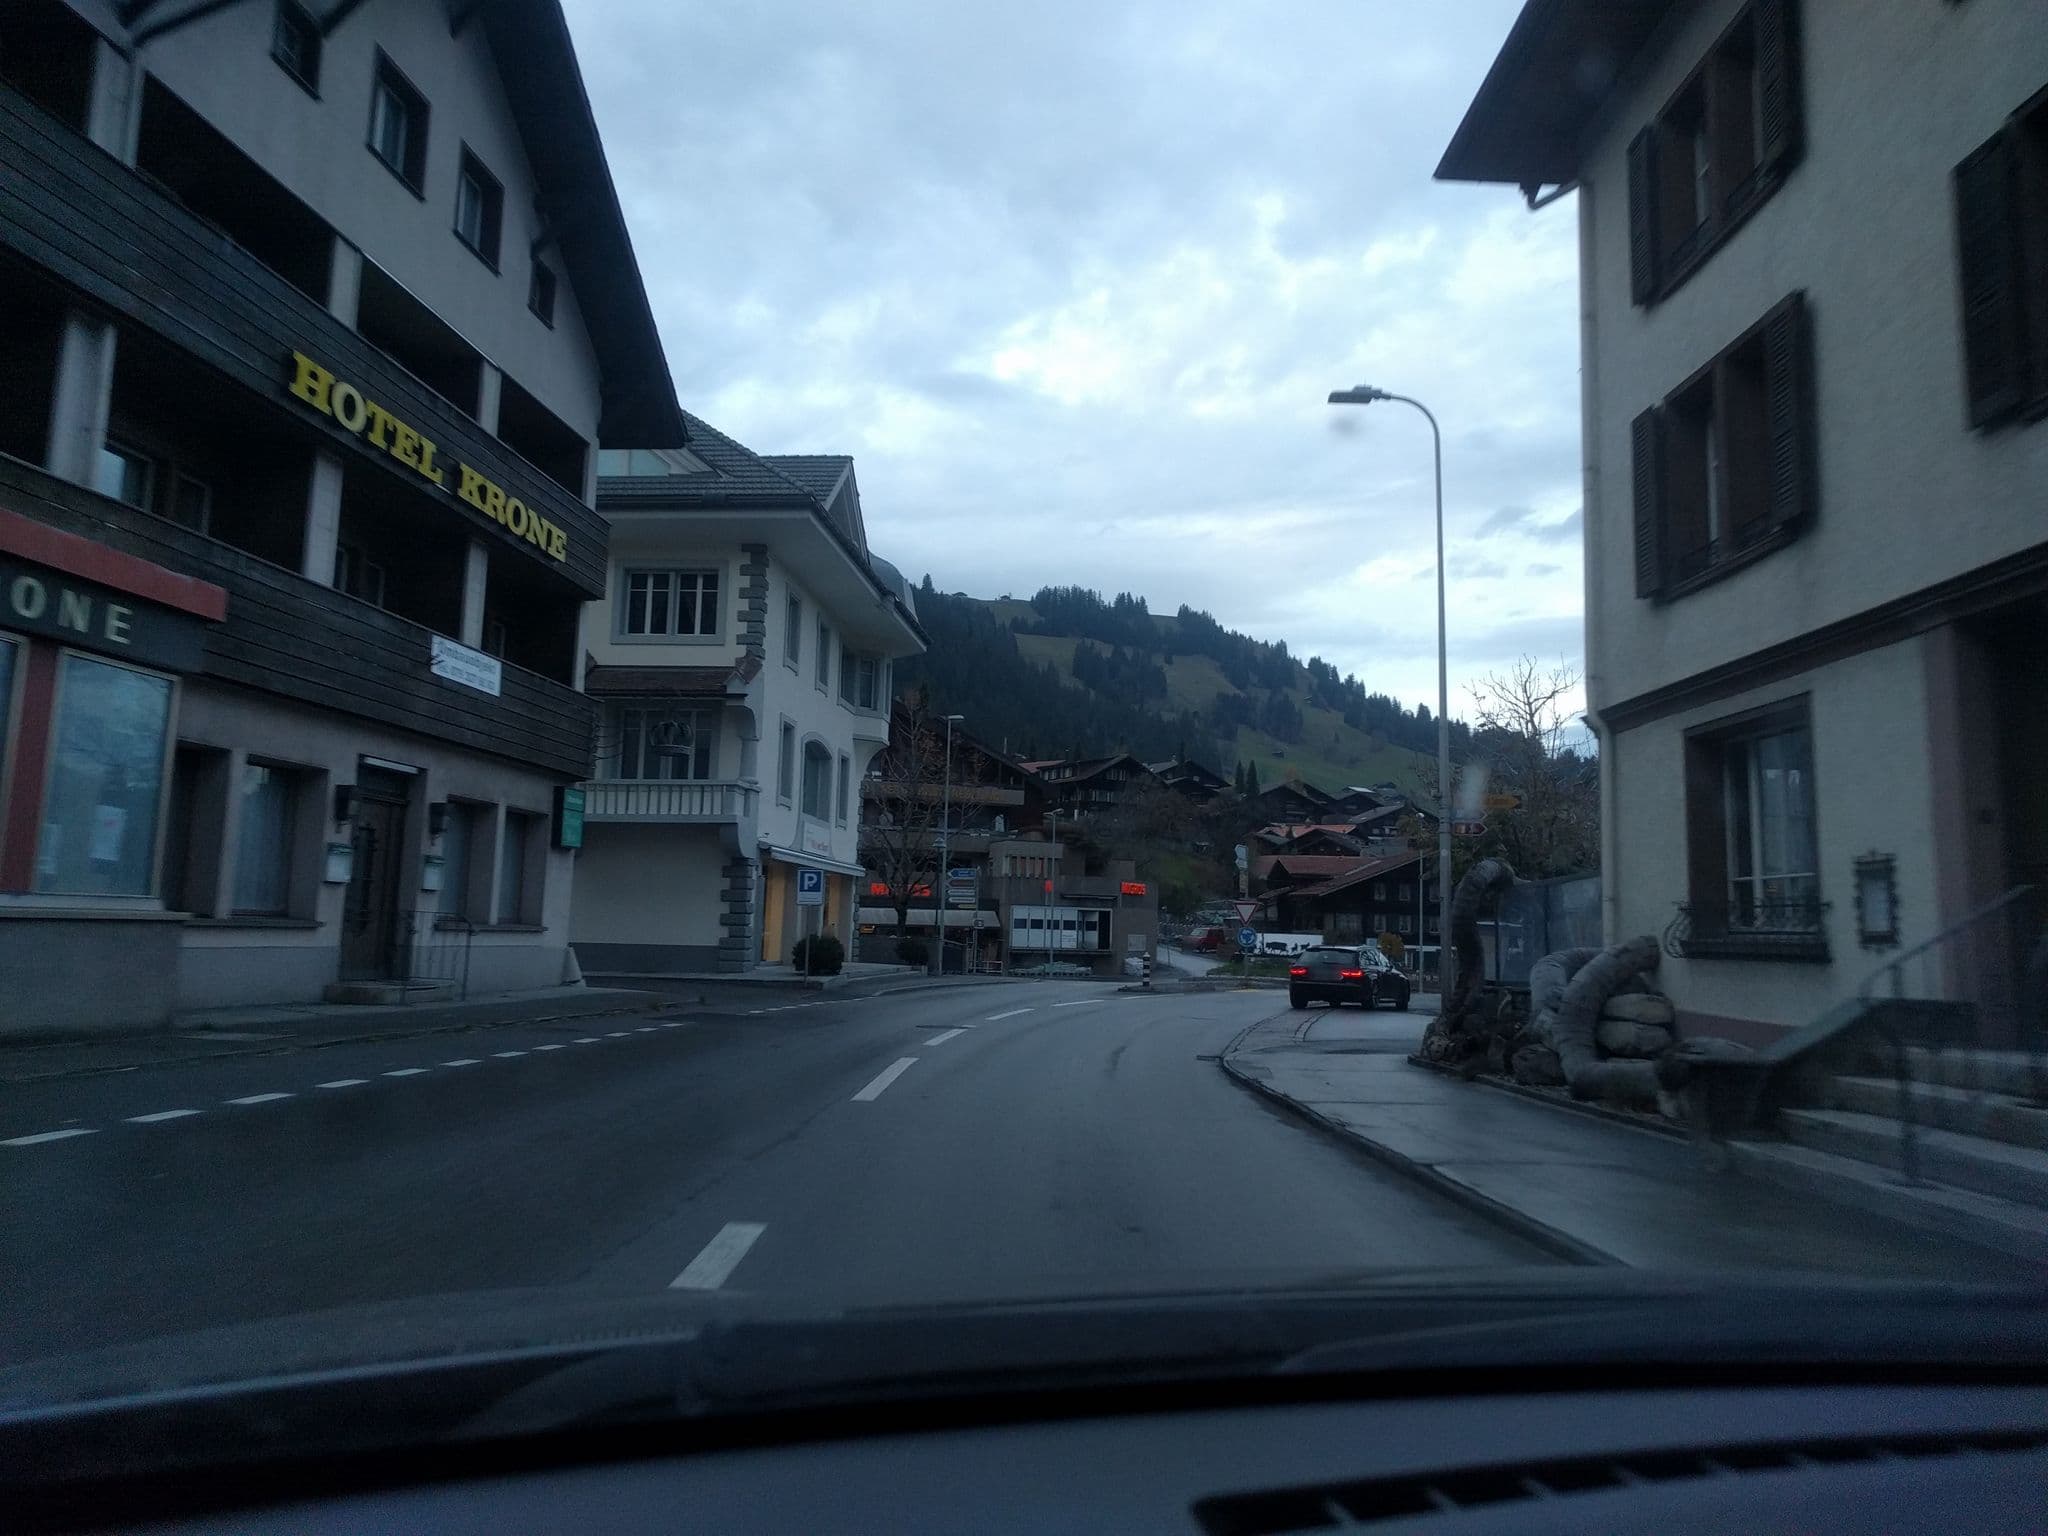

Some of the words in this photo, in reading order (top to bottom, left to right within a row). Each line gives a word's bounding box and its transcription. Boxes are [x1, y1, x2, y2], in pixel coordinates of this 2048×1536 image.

[289, 350, 443, 485] HOTEL
[457, 462, 568, 563] KRONE
[803, 872, 818, 890] P
